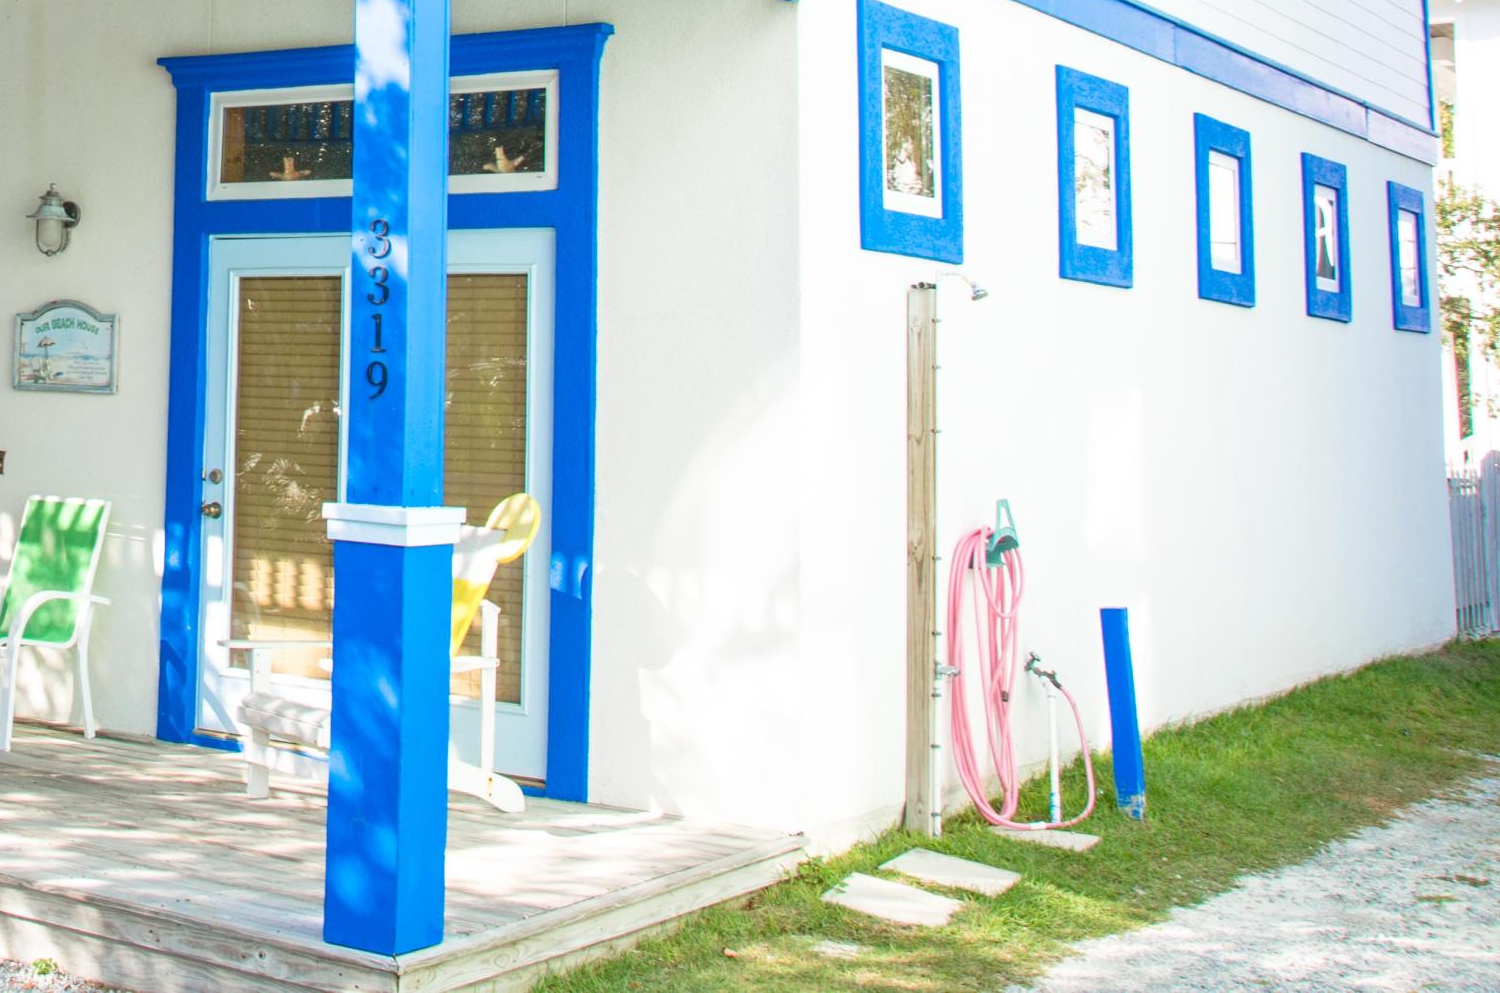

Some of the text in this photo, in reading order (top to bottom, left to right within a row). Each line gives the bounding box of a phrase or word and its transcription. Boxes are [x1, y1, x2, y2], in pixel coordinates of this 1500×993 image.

[35, 318, 100, 335] OUR BEACH HOUSE
[366, 219, 392, 400] 3319
